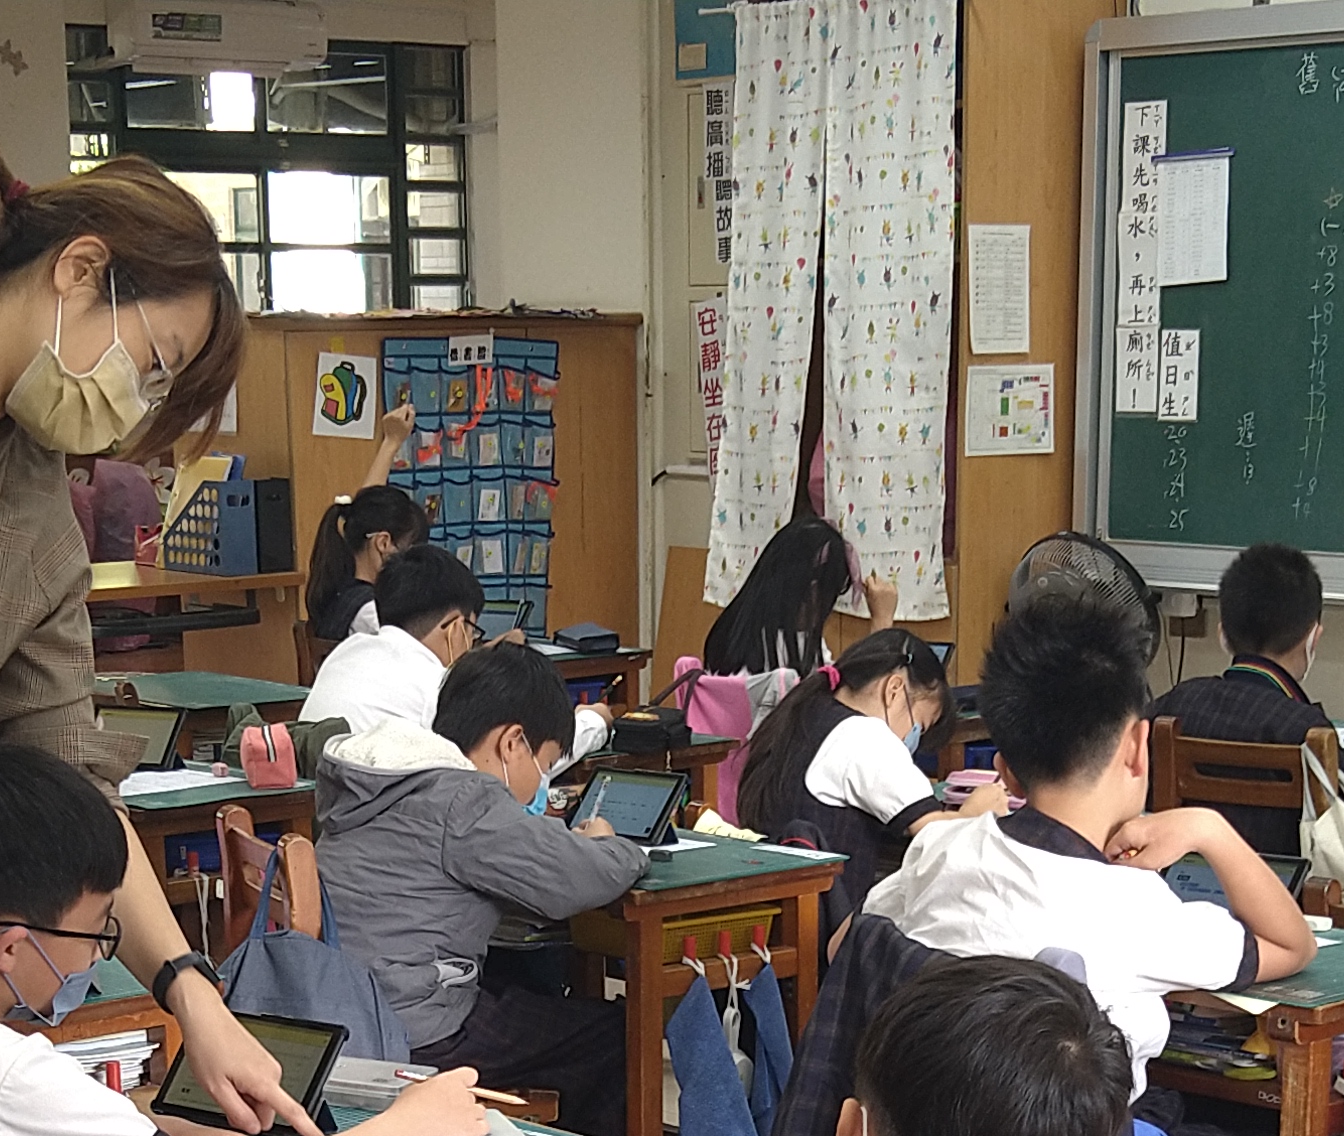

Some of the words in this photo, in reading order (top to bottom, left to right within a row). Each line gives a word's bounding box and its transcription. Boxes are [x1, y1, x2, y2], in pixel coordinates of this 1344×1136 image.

[706, 89, 724, 179] 聽廣播
[1161, 332, 1183, 417] 值日生
[1169, 509, 1189, 531] 25
